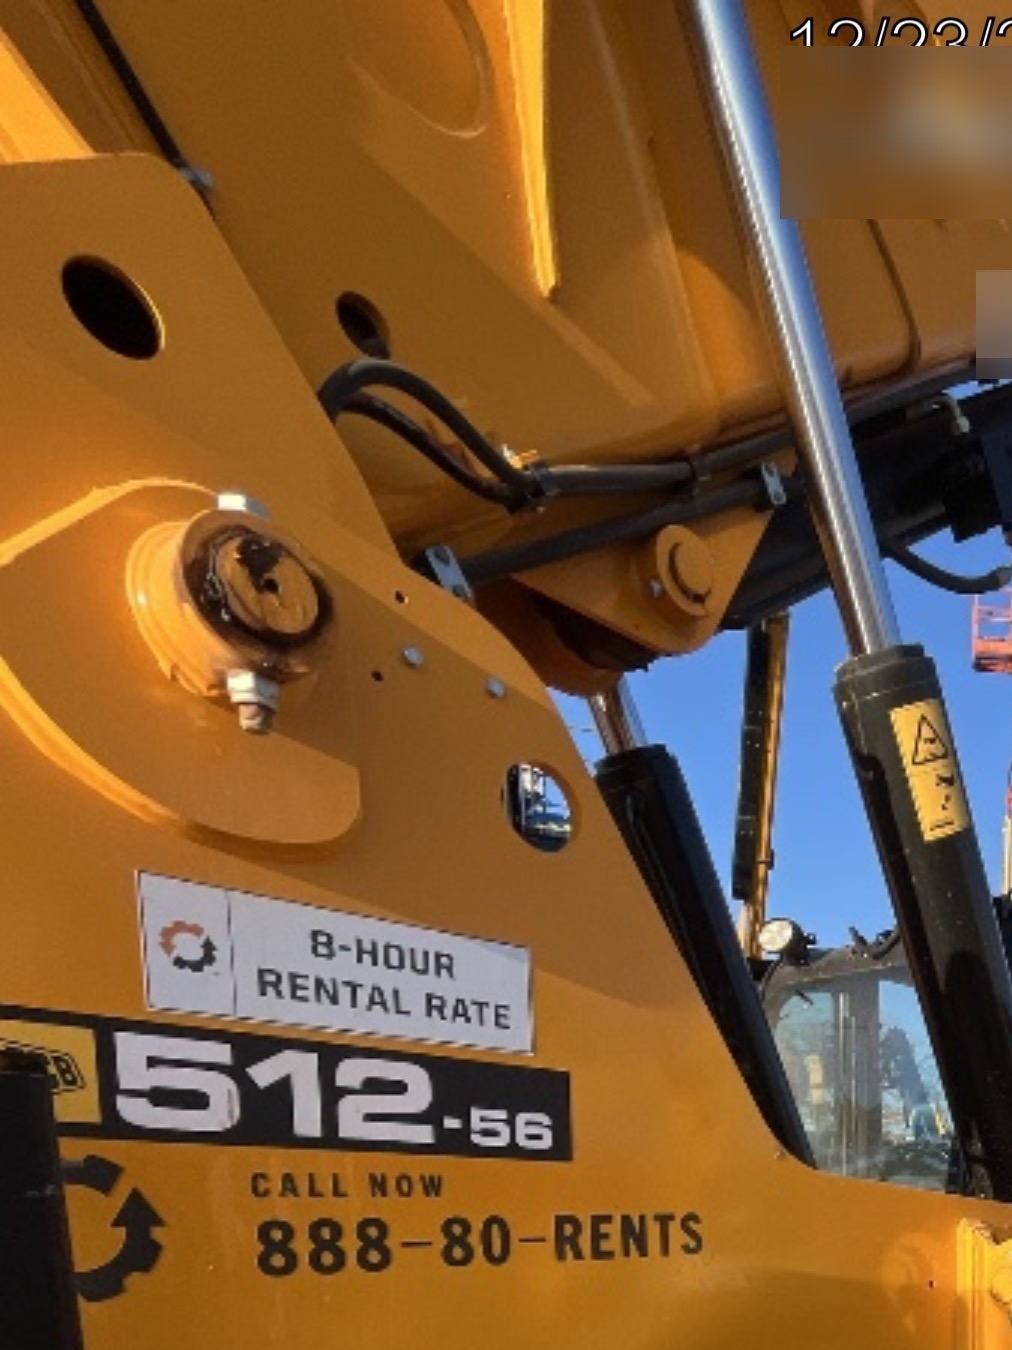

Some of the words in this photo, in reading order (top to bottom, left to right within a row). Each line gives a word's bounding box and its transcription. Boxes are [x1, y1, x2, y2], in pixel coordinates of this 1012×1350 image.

[309, 928, 456, 981] 8-HOUR
[256, 966, 411, 1017] RENTAL
[424, 992, 512, 1031] RATE
[112, 1030, 555, 1151] 512-56
[250, 1171, 349, 1199] CALL
[368, 1172, 445, 1199] NOW
